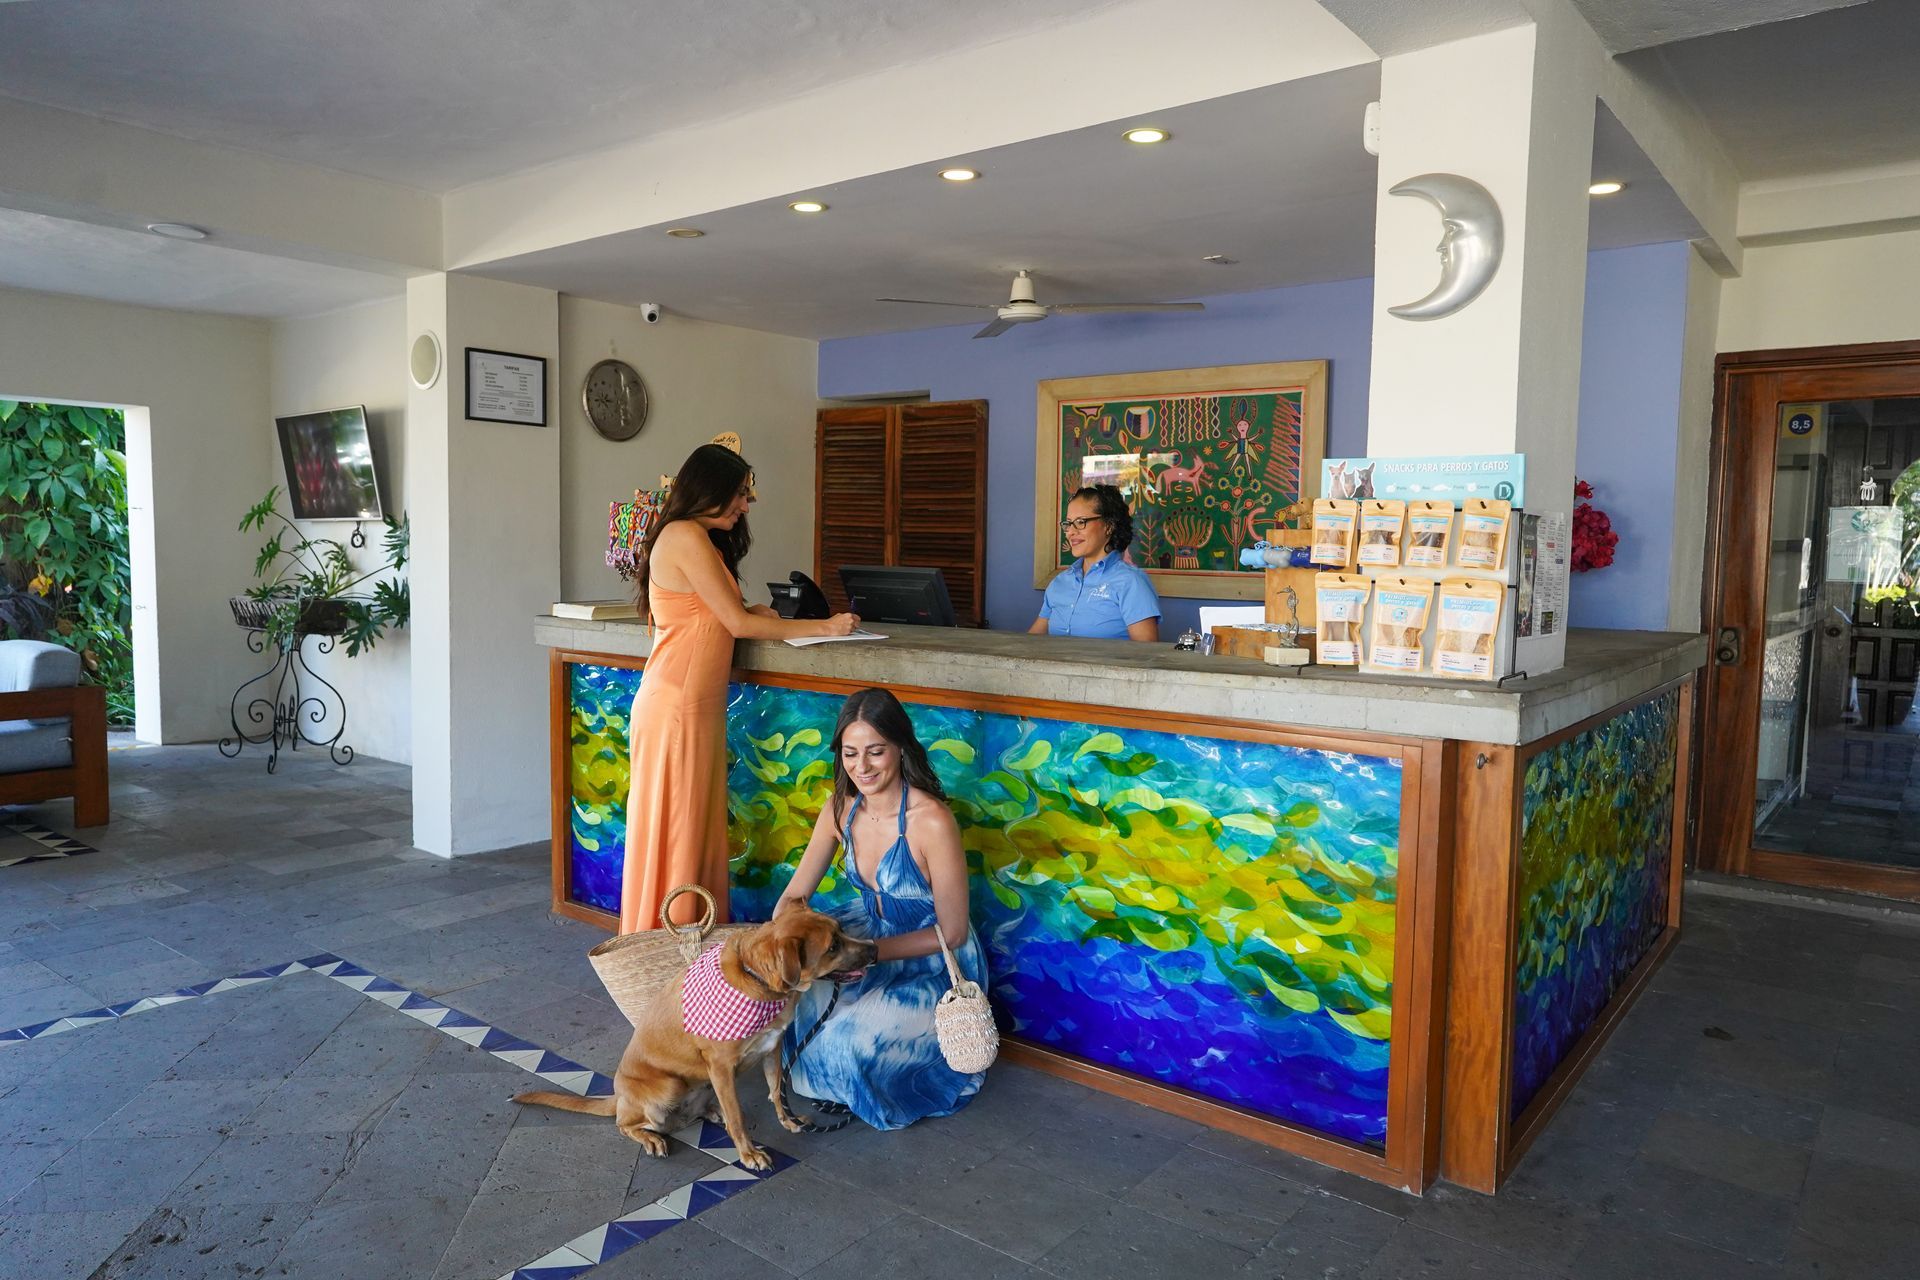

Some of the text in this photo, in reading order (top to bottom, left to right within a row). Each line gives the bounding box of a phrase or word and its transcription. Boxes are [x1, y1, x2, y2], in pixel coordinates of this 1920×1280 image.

[1791, 419, 1811, 430] 8,5
[1383, 460, 1509, 473] SNACKS PARA PERROS Y GATOS
